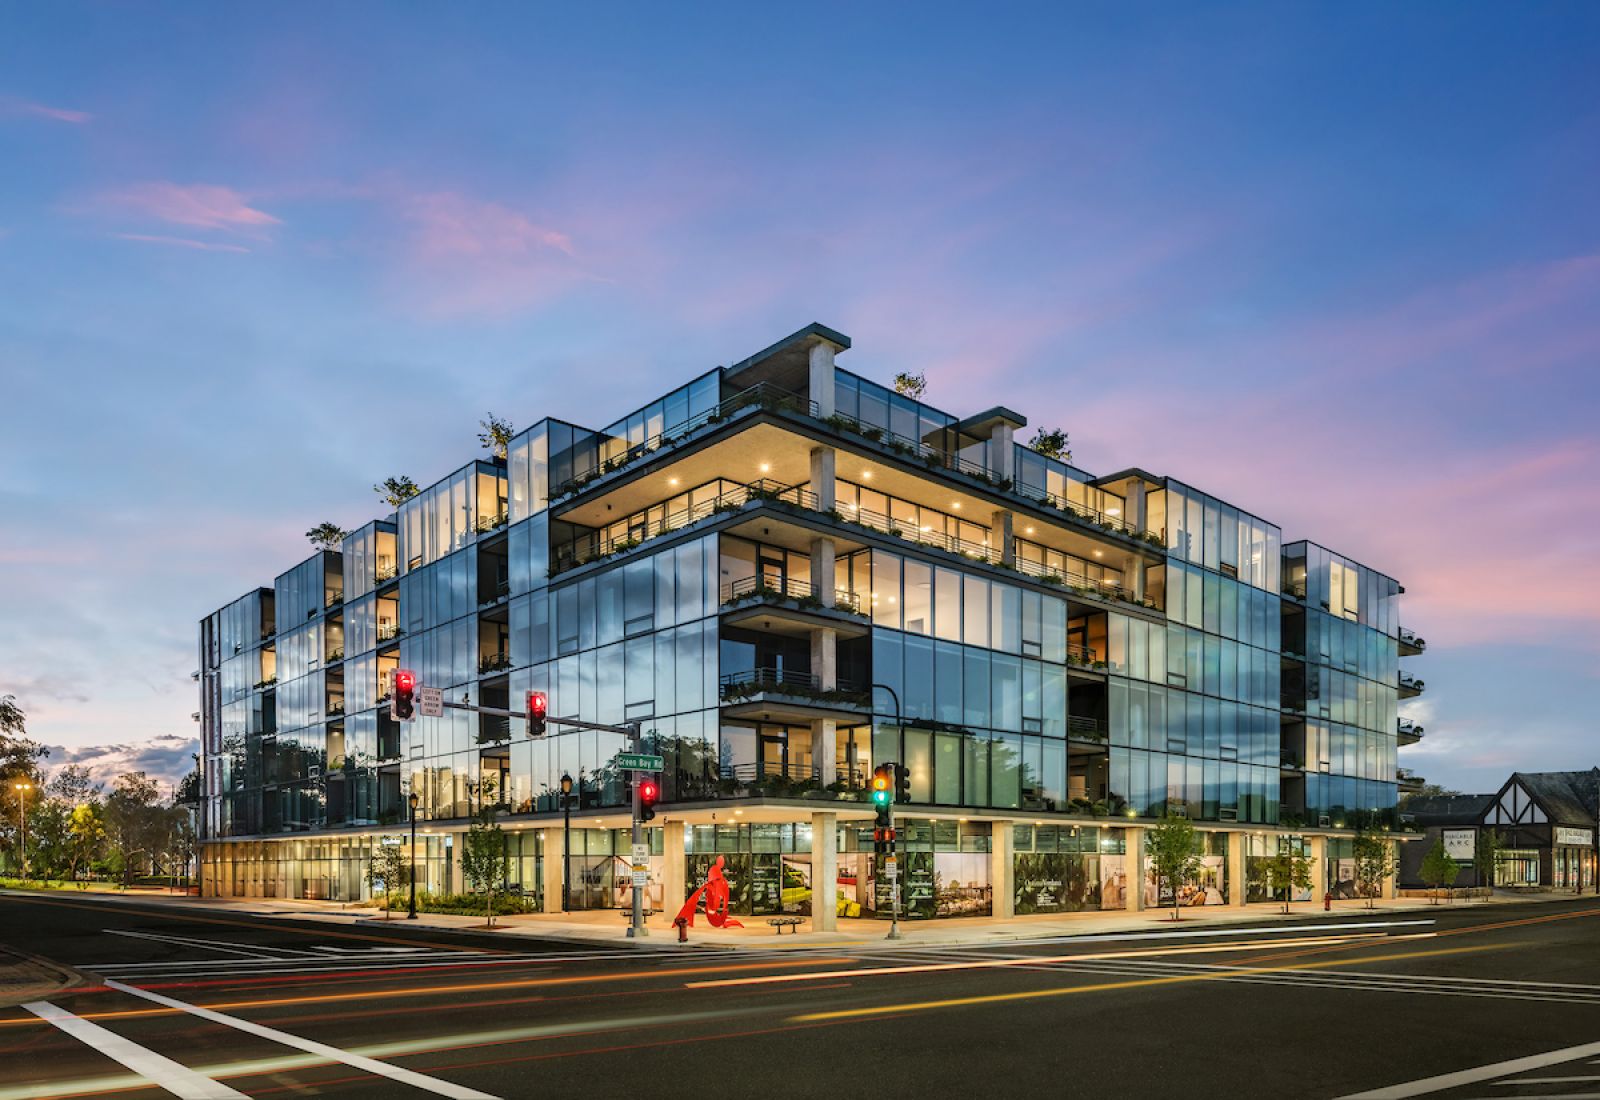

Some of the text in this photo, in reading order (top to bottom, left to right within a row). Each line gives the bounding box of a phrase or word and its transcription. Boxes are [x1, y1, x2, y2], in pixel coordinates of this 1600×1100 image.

[619, 757, 662, 769] Green Bay Rd
